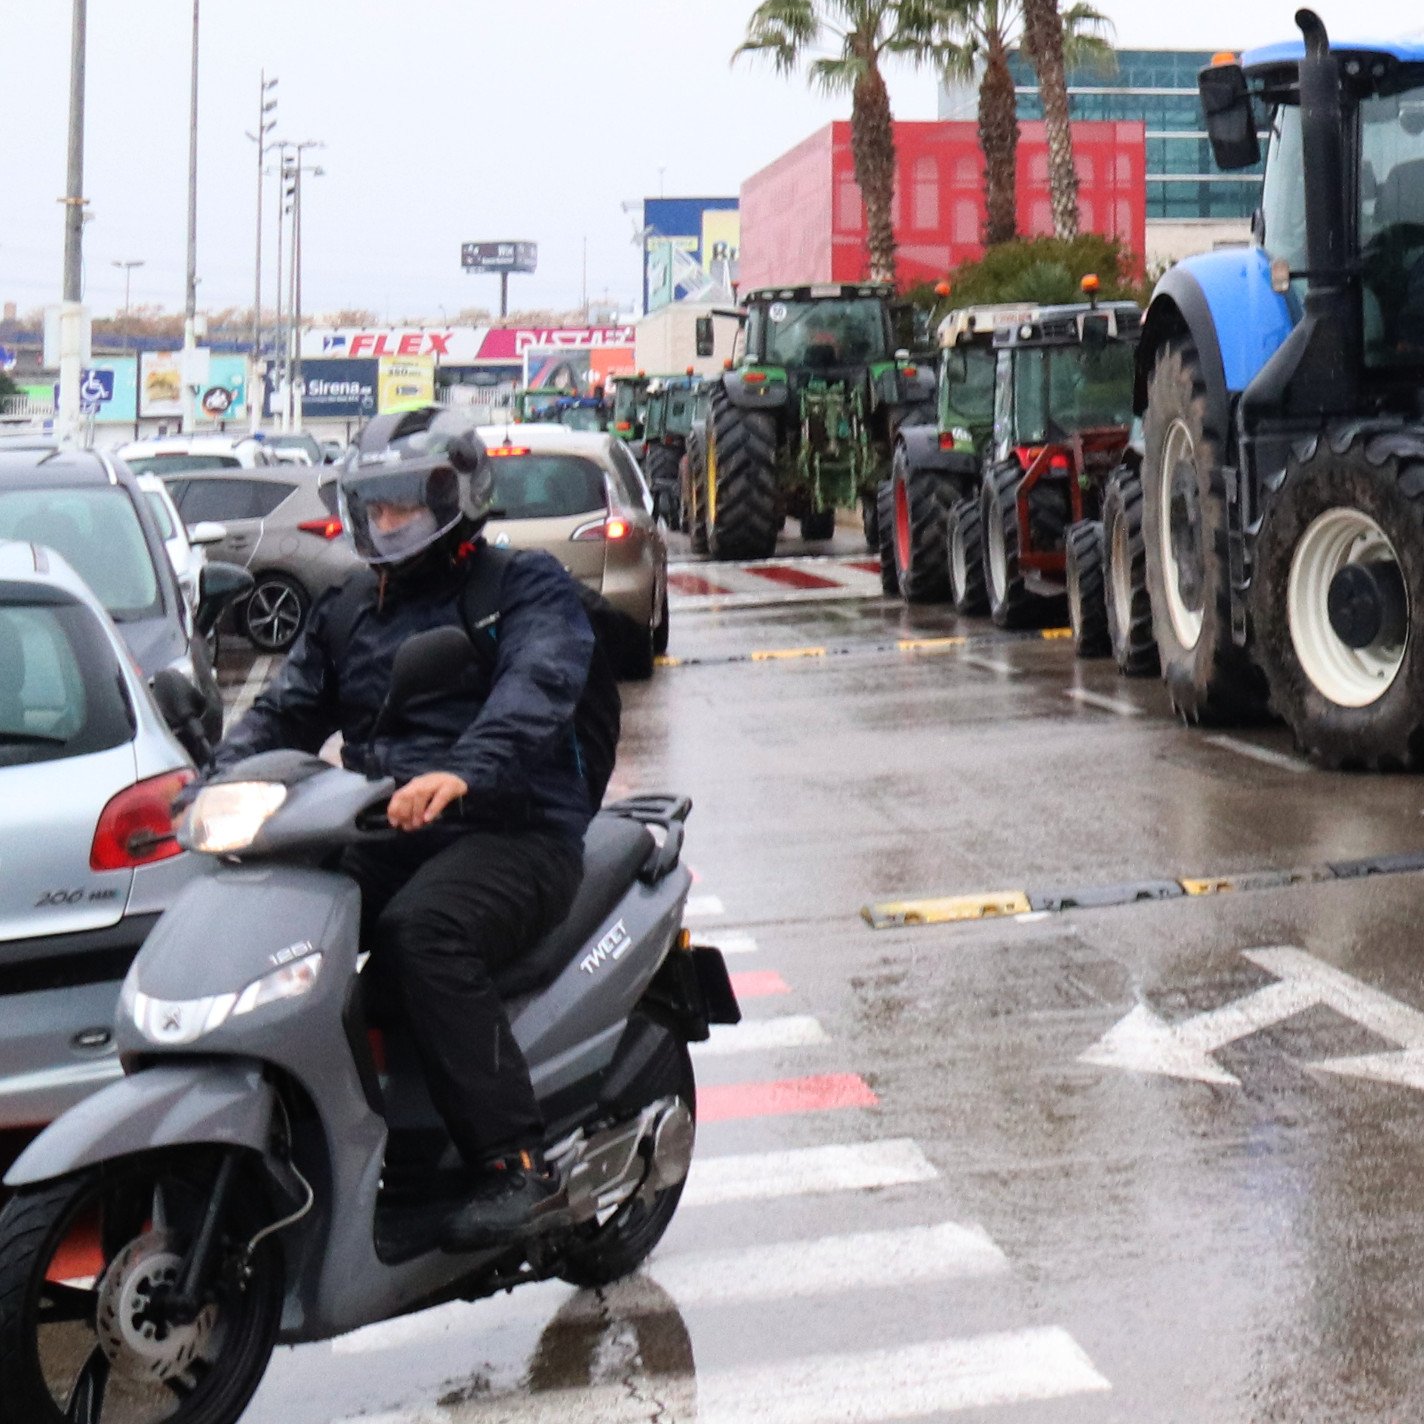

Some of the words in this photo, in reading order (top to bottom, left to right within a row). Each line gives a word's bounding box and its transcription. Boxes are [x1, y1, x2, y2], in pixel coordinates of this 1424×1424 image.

[348, 334, 453, 358] FLEX
[309, 378, 361, 396] Sirena
[35, 888, 84, 907] 206
[580, 918, 626, 974] TWEET
